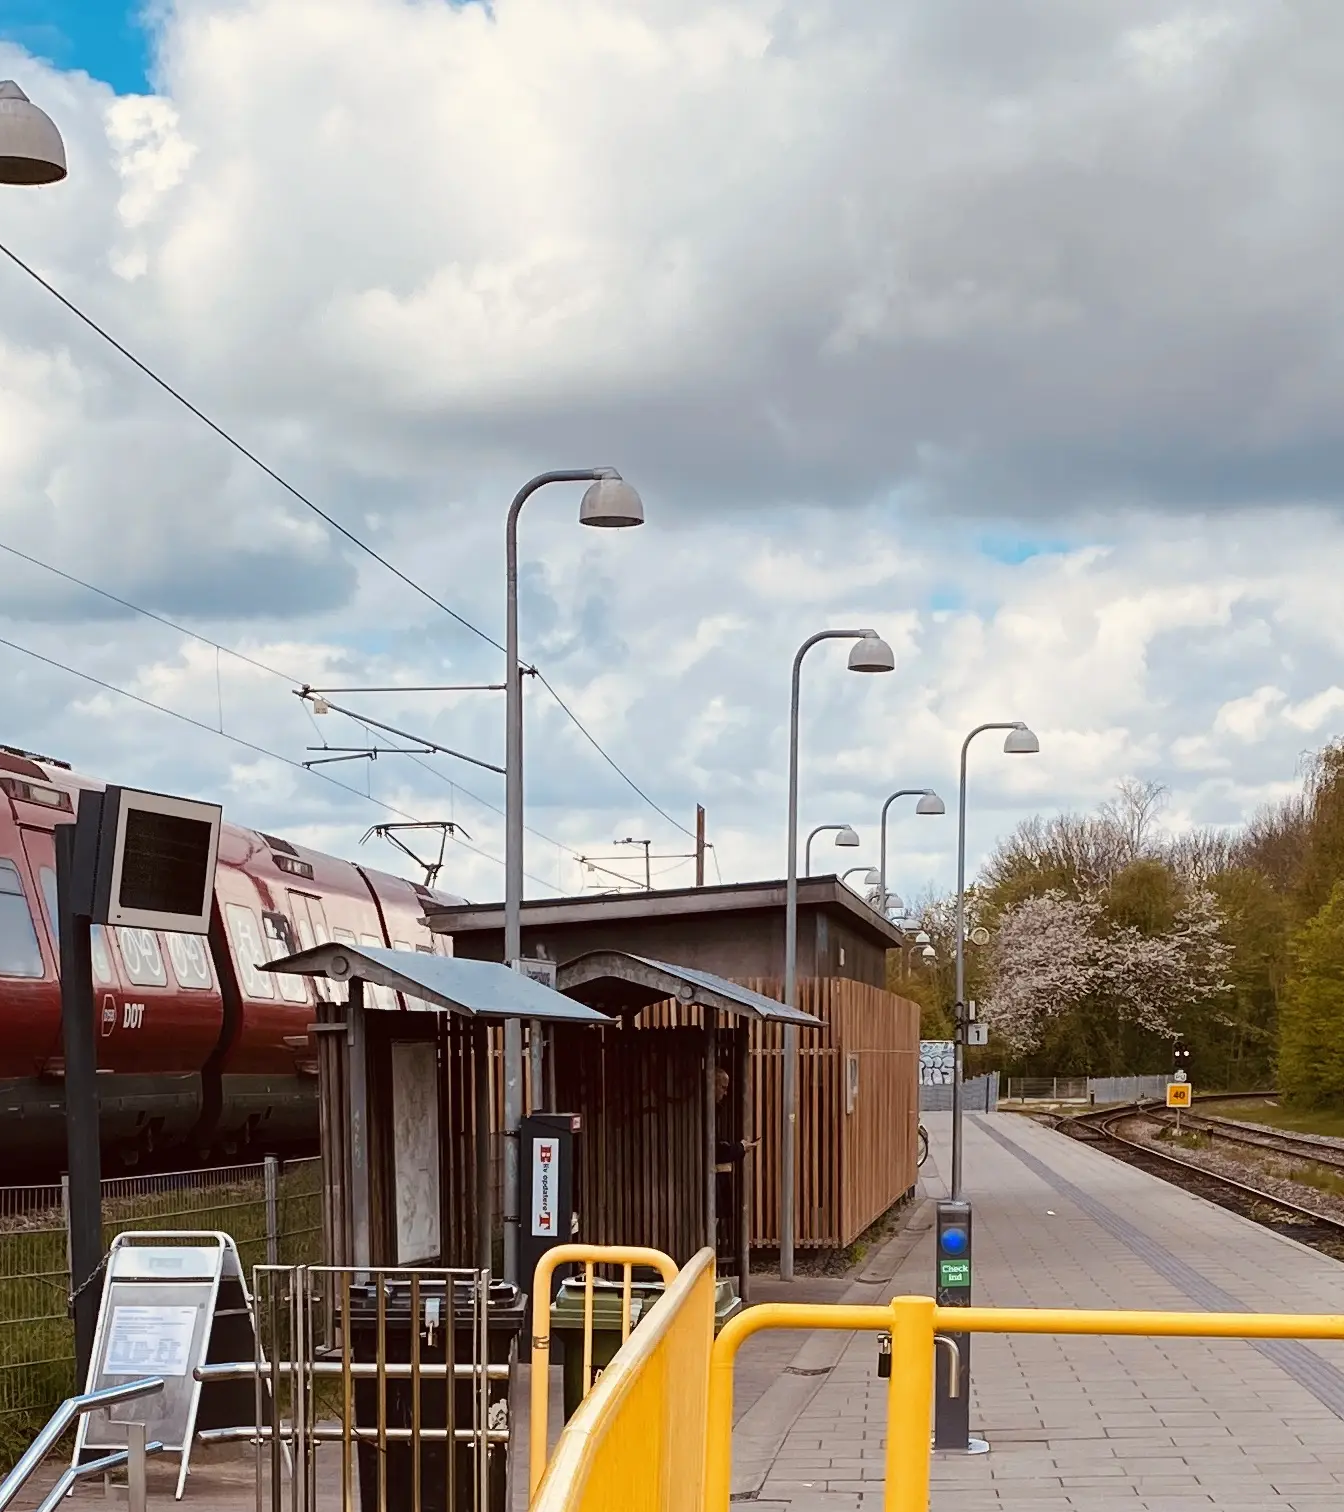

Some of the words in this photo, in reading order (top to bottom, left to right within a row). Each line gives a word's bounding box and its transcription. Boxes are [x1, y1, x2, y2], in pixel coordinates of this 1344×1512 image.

[123, 1003, 145, 1029] DOT
[975, 1030, 980, 1042] 1
[1173, 1091, 1186, 1100] 40
[942, 1264, 968, 1273] Check
